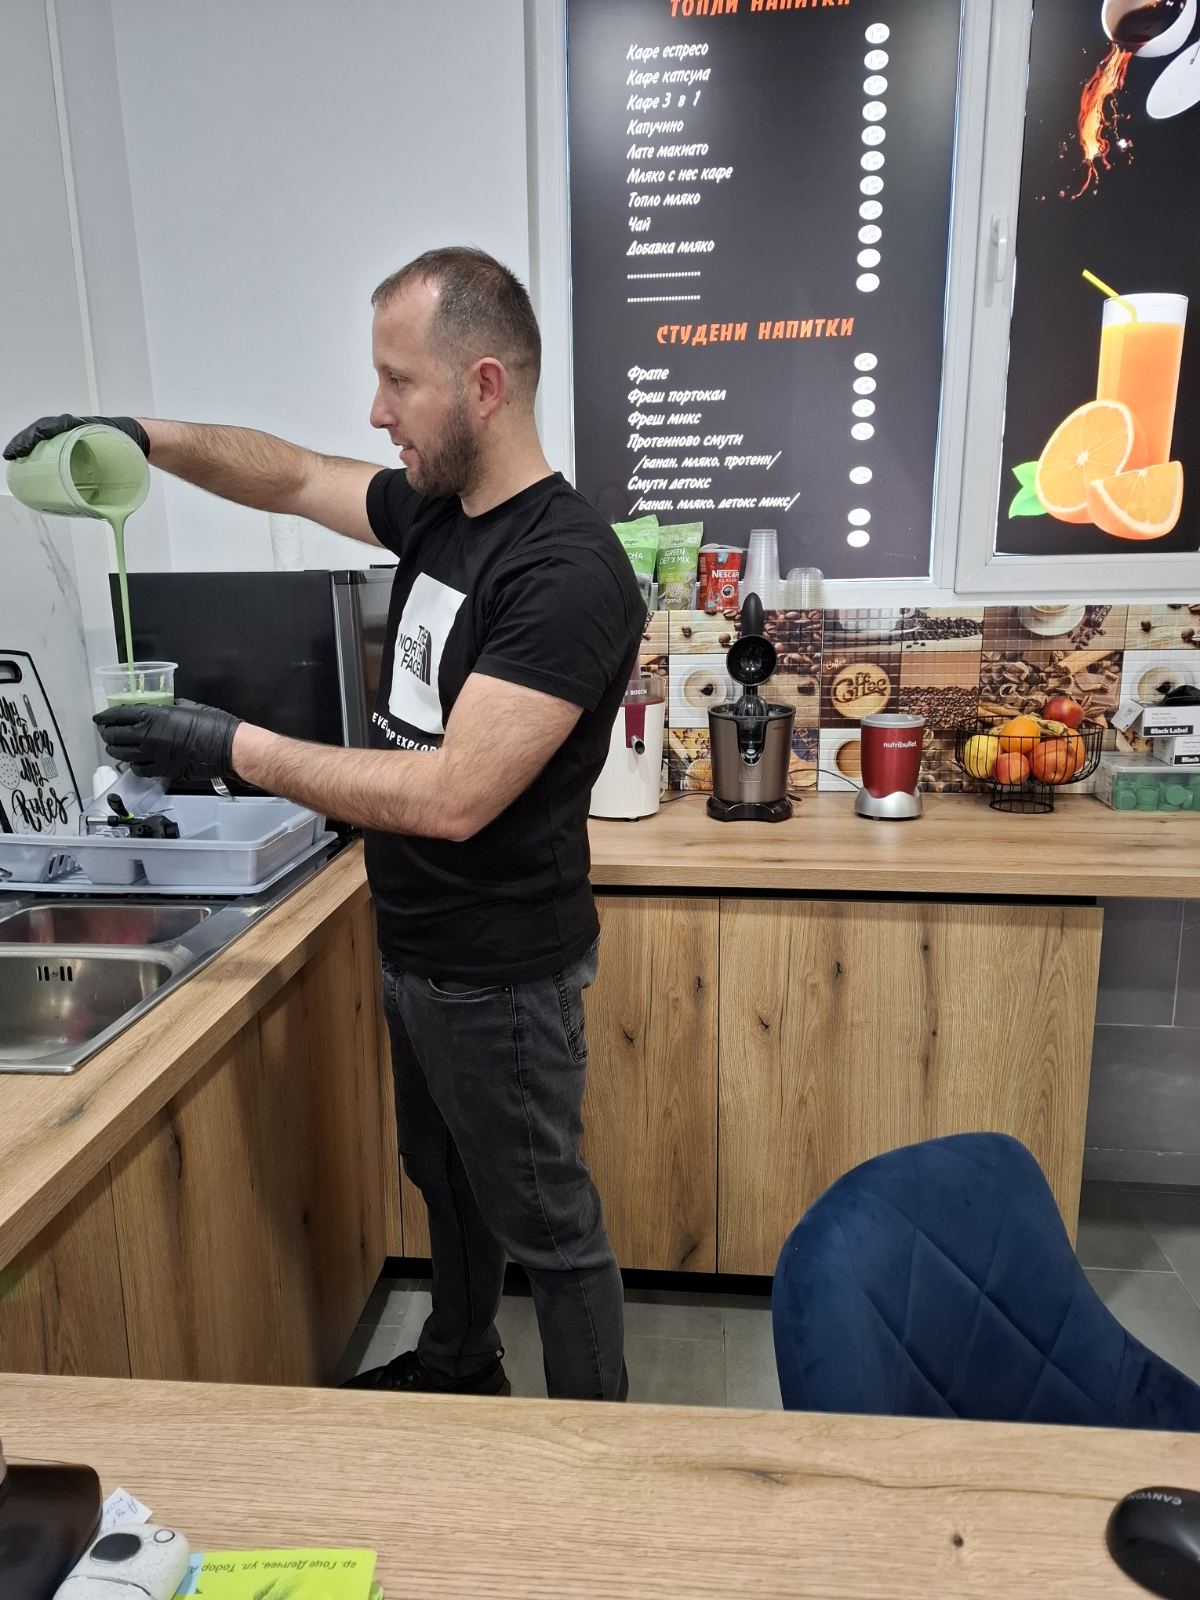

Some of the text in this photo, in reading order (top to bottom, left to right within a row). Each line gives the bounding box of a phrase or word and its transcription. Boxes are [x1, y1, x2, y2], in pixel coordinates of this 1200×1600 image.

[671, 0, 739, 17] ТОПЛИ
[627, 43, 709, 63] Кафе еспресо
[627, 68, 711, 88] Кафе капсула
[627, 90, 701, 113] Кафе 3 в 1
[627, 120, 684, 137] Капучино
[627, 143, 709, 159] Лате макиато
[627, 167, 733, 184] Мляко с нес кафе
[629, 192, 701, 207] Топло мляко
[629, 216, 651, 232] Чай
[626, 240, 715, 256] Добавка мляко
[656, 317, 855, 346] СТУДЕНИ НАПИТКИ
[627, 365, 669, 384] Фрапе
[628, 388, 726, 407] Фреш портокал
[628, 411, 702, 430] Фреш микс
[627, 433, 744, 452] Протеиново смути
[724, 451, 782, 470] протеин/
[627, 476, 712, 493] Смути детокс
[717, 498, 757, 509] детокс
[758, 492, 800, 511] микс/
[417, 624, 429, 647] THE
[398, 633, 424, 662] NORTH
[400, 653, 422, 679] FACE
[832, 671, 888, 704] Coffee
[1150, 726, 1189, 735] Black Label
[20, 757, 50, 787] My
[12, 786, 69, 833] Rules
[309, 1560, 337, 1571] Гоце
